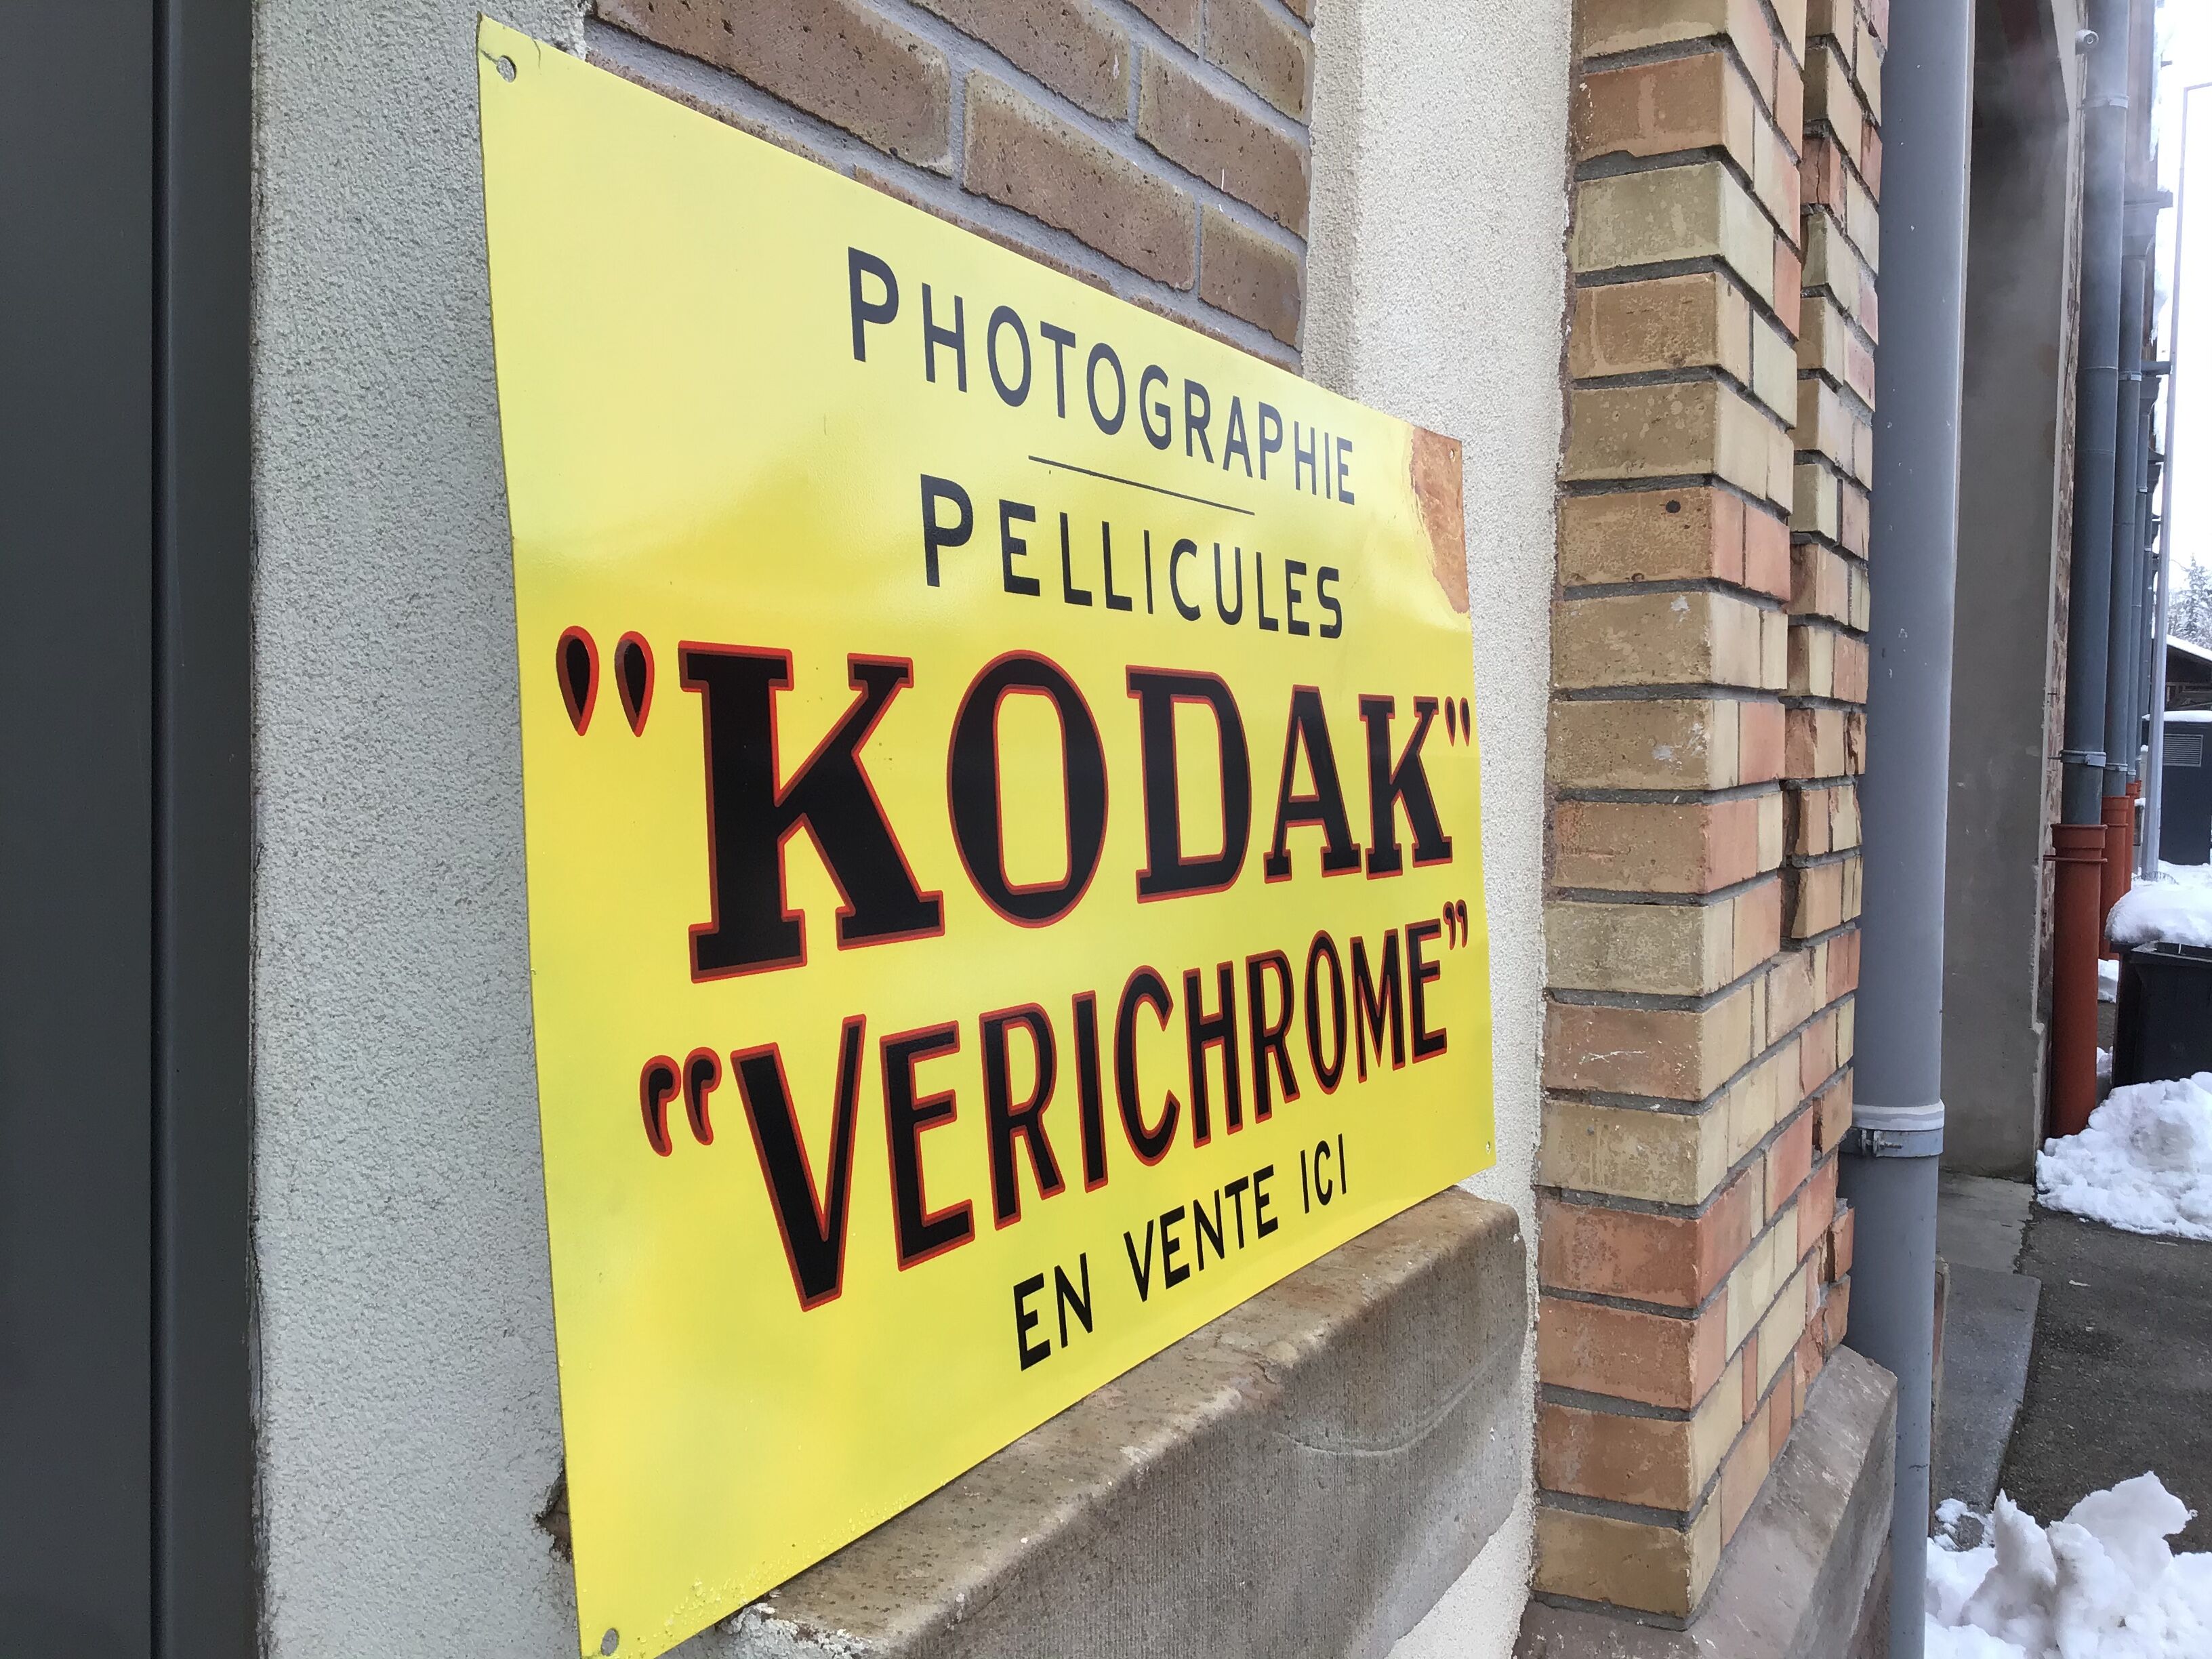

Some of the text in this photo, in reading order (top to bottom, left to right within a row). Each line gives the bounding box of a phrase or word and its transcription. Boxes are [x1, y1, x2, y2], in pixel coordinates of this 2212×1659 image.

[847, 247, 1355, 506] PHOTOGRAPHIE
[920, 474, 1343, 639] PELLICULES
[1013, 1134, 1347, 1372] EN VENTE ICI
